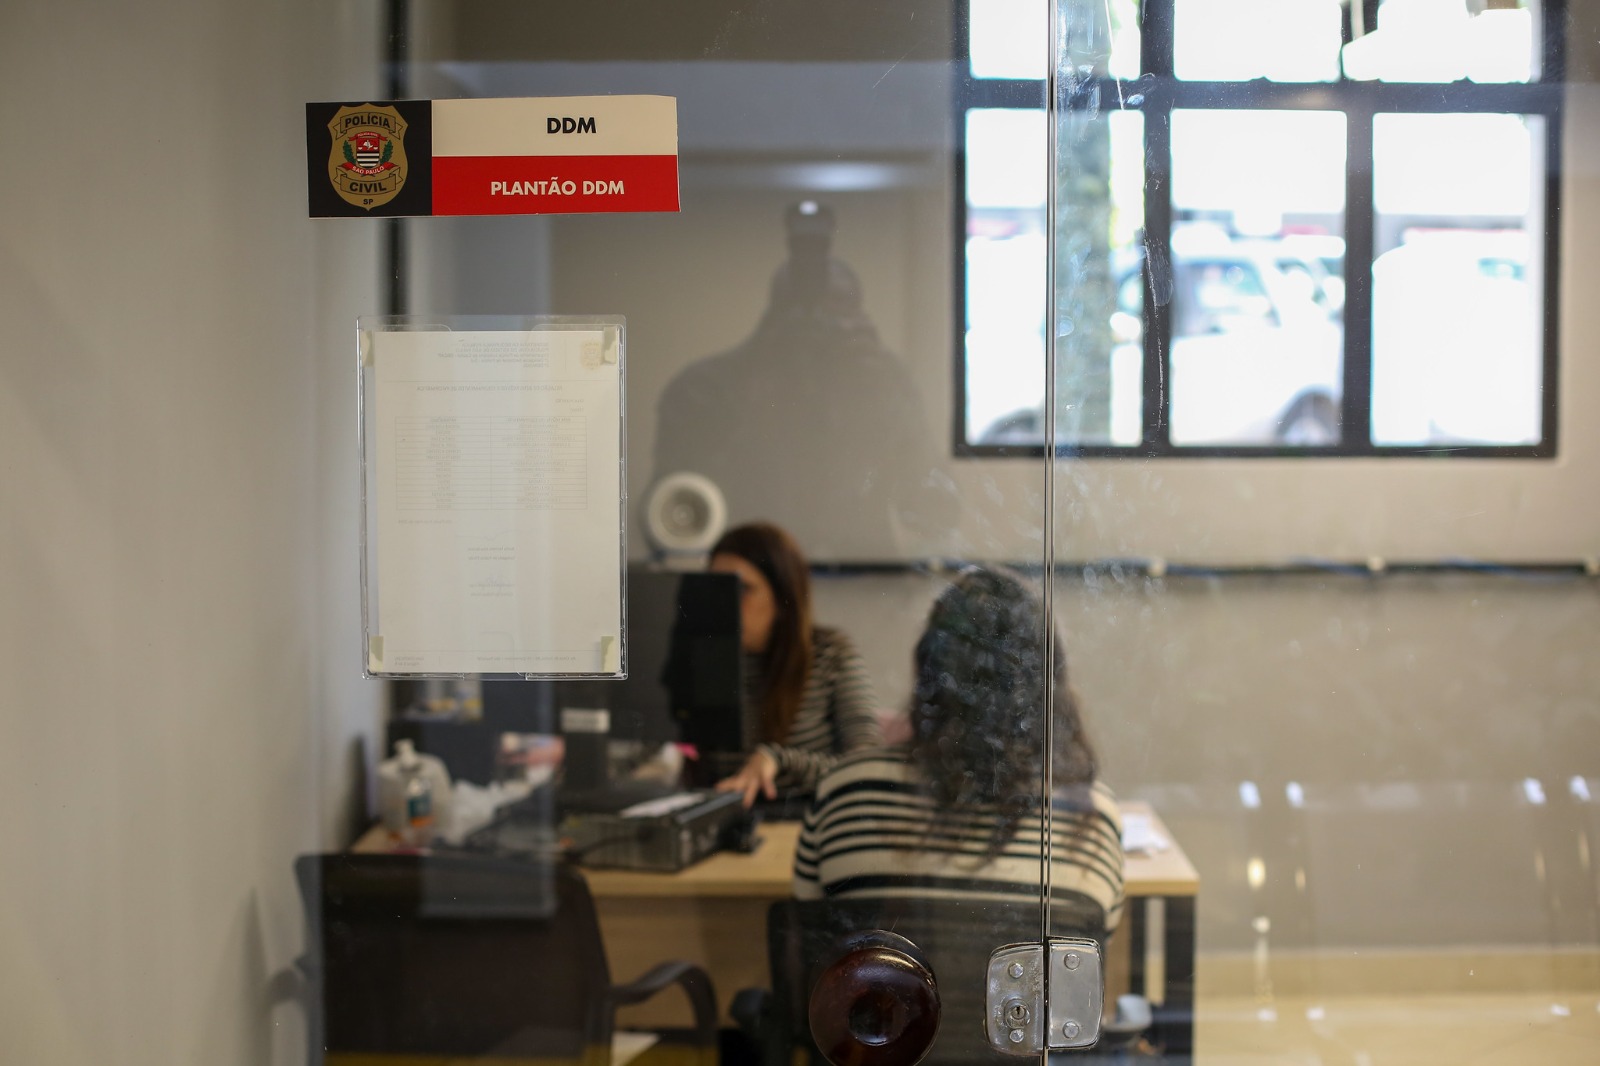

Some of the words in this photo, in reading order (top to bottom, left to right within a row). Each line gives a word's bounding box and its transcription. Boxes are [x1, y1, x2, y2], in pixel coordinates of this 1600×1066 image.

[345, 113, 390, 128] POLÍCIA
[547, 117, 596, 133] DDM
[365, 166, 385, 174] PAULO
[349, 182, 387, 193] CIVIL
[491, 177, 577, 196] PLANTÃO
[583, 181, 624, 196] DDM
